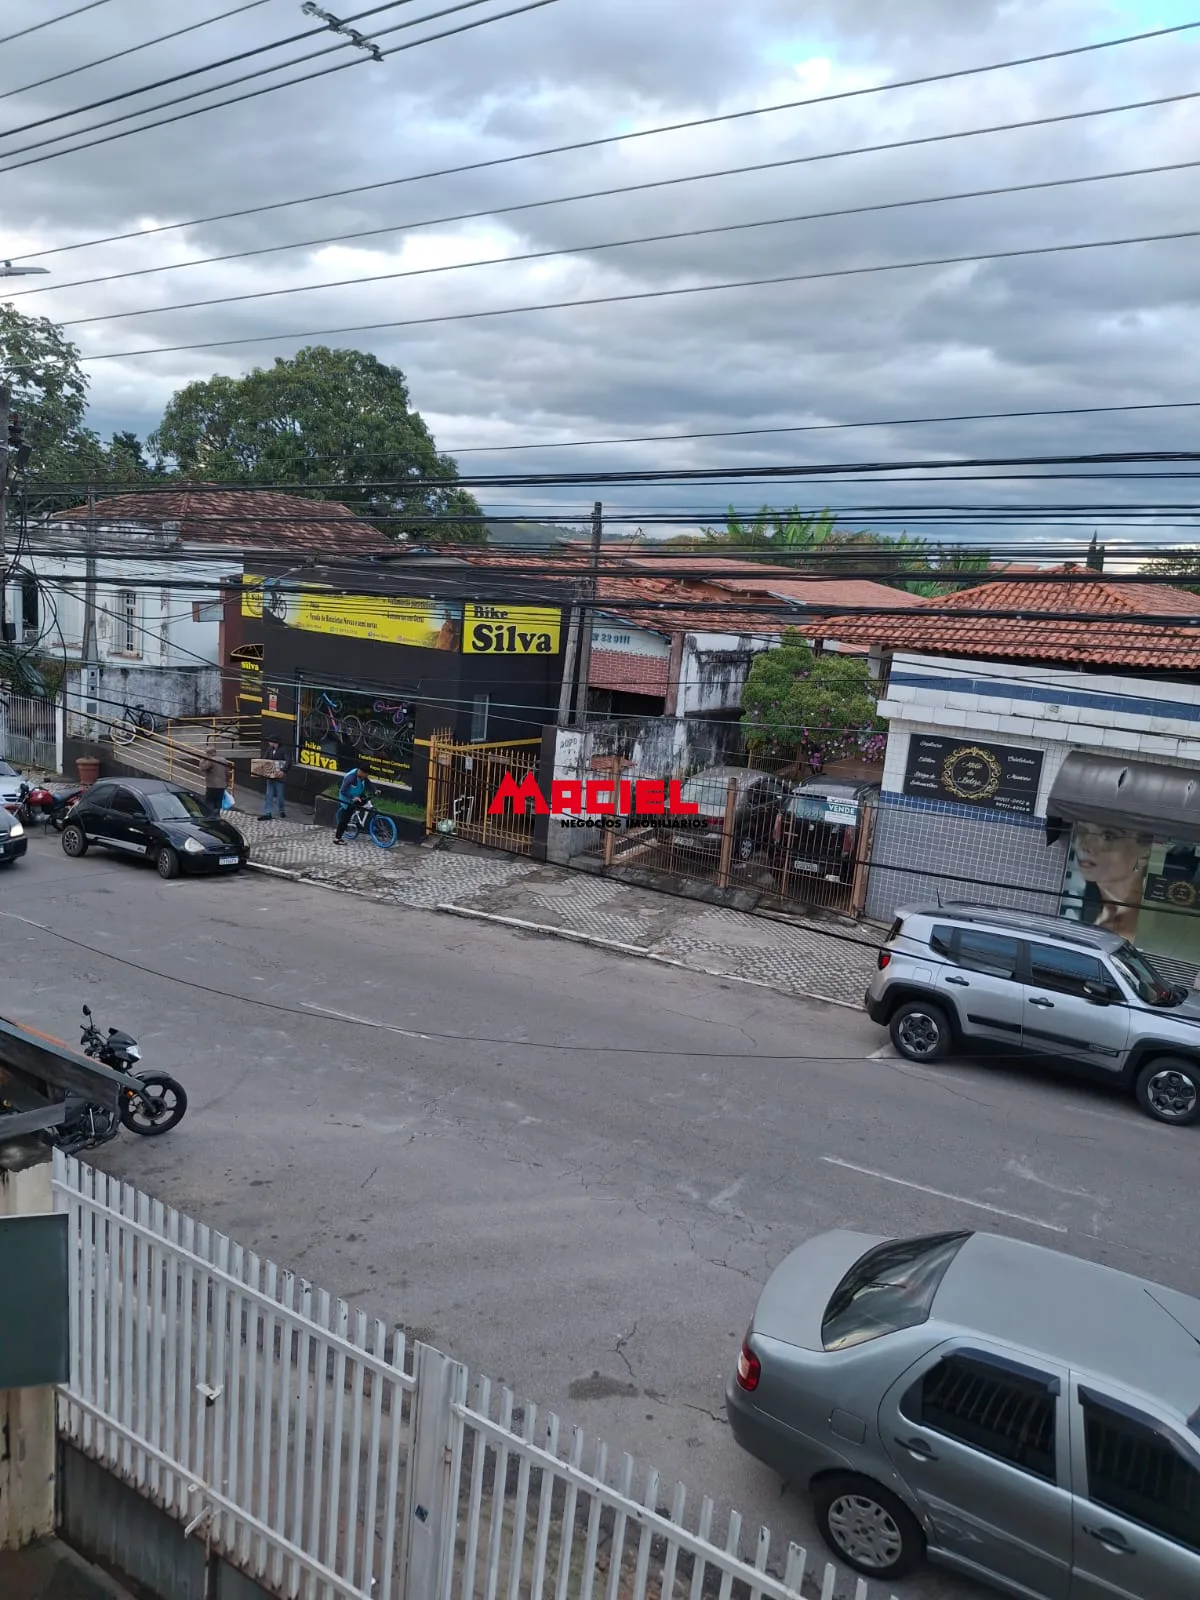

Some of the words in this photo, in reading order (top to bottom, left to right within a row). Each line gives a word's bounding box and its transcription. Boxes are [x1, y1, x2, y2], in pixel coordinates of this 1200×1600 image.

[474, 606, 508, 619] Bike
[472, 623, 552, 653] Silva
[300, 749, 338, 771] Silva
[828, 804, 856, 816] VENDE
